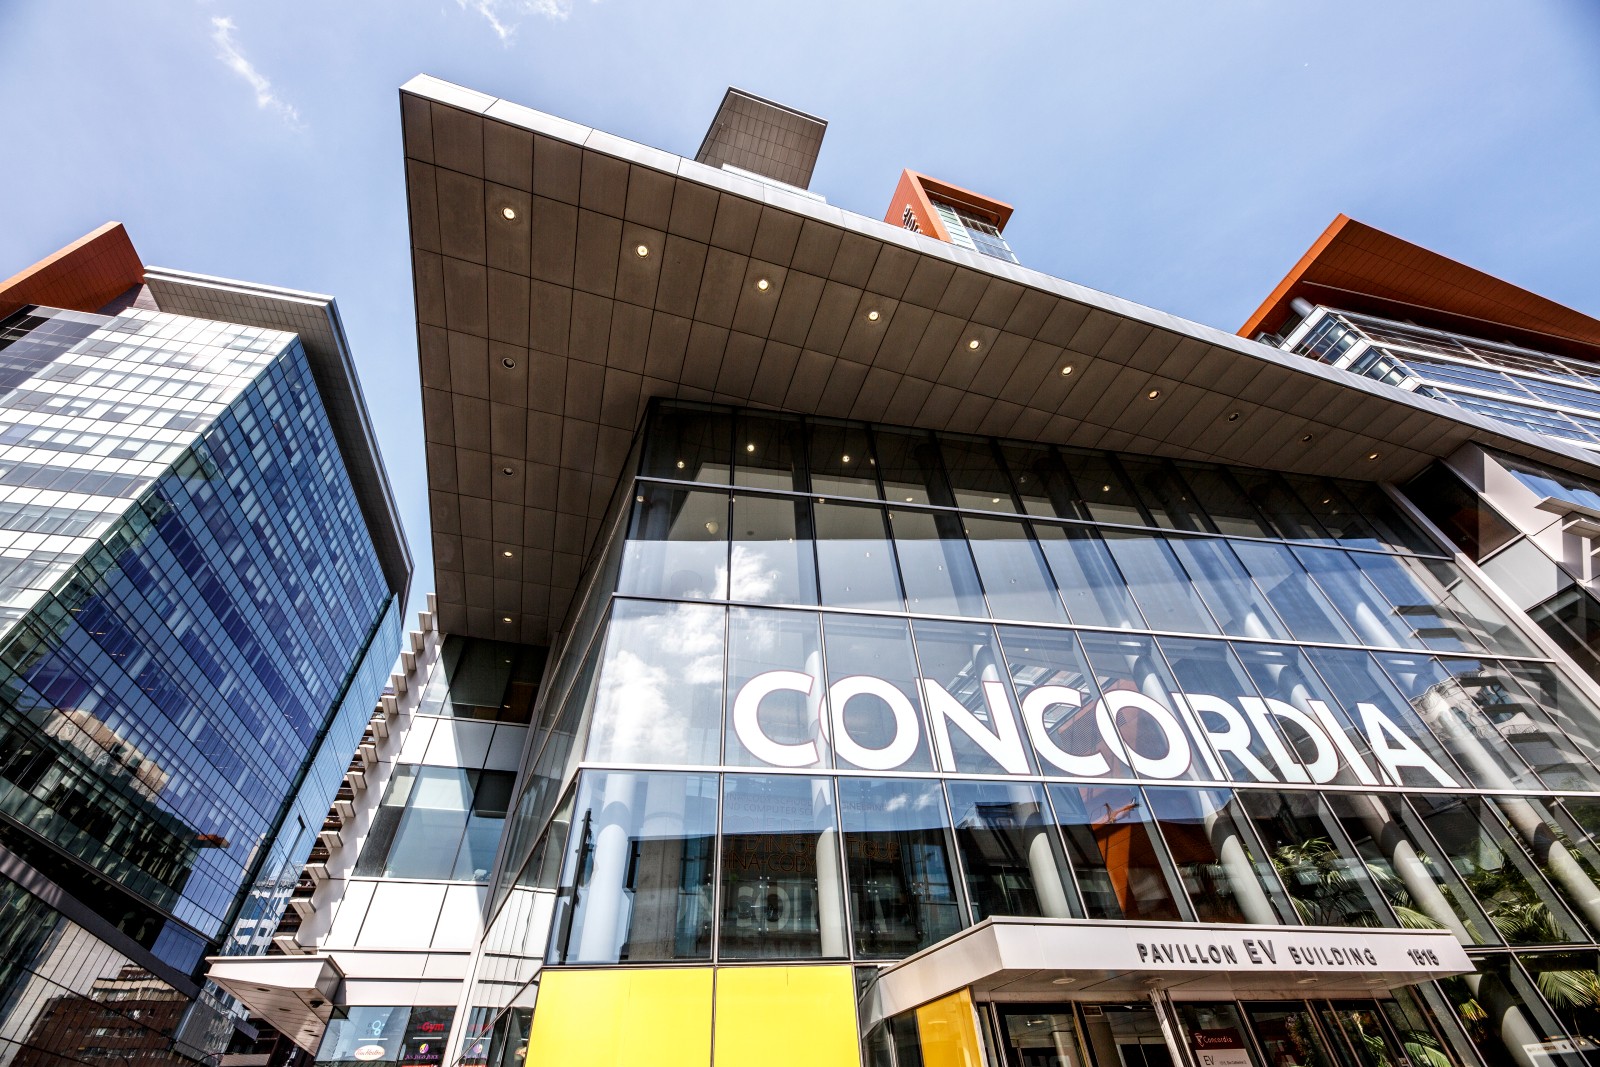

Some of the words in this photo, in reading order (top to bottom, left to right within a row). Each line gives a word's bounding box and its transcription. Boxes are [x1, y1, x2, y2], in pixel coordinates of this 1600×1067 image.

[733, 670, 1463, 789] CONCORDIA
[1136, 943, 1238, 965] PAVILLON
[1243, 939, 1277, 964] EV
[1288, 946, 1378, 966] BUILDING
[1406, 949, 1439, 966] 1515
[1203, 1035, 1233, 1044] Concordia
[1203, 1056, 1215, 1066] EV
